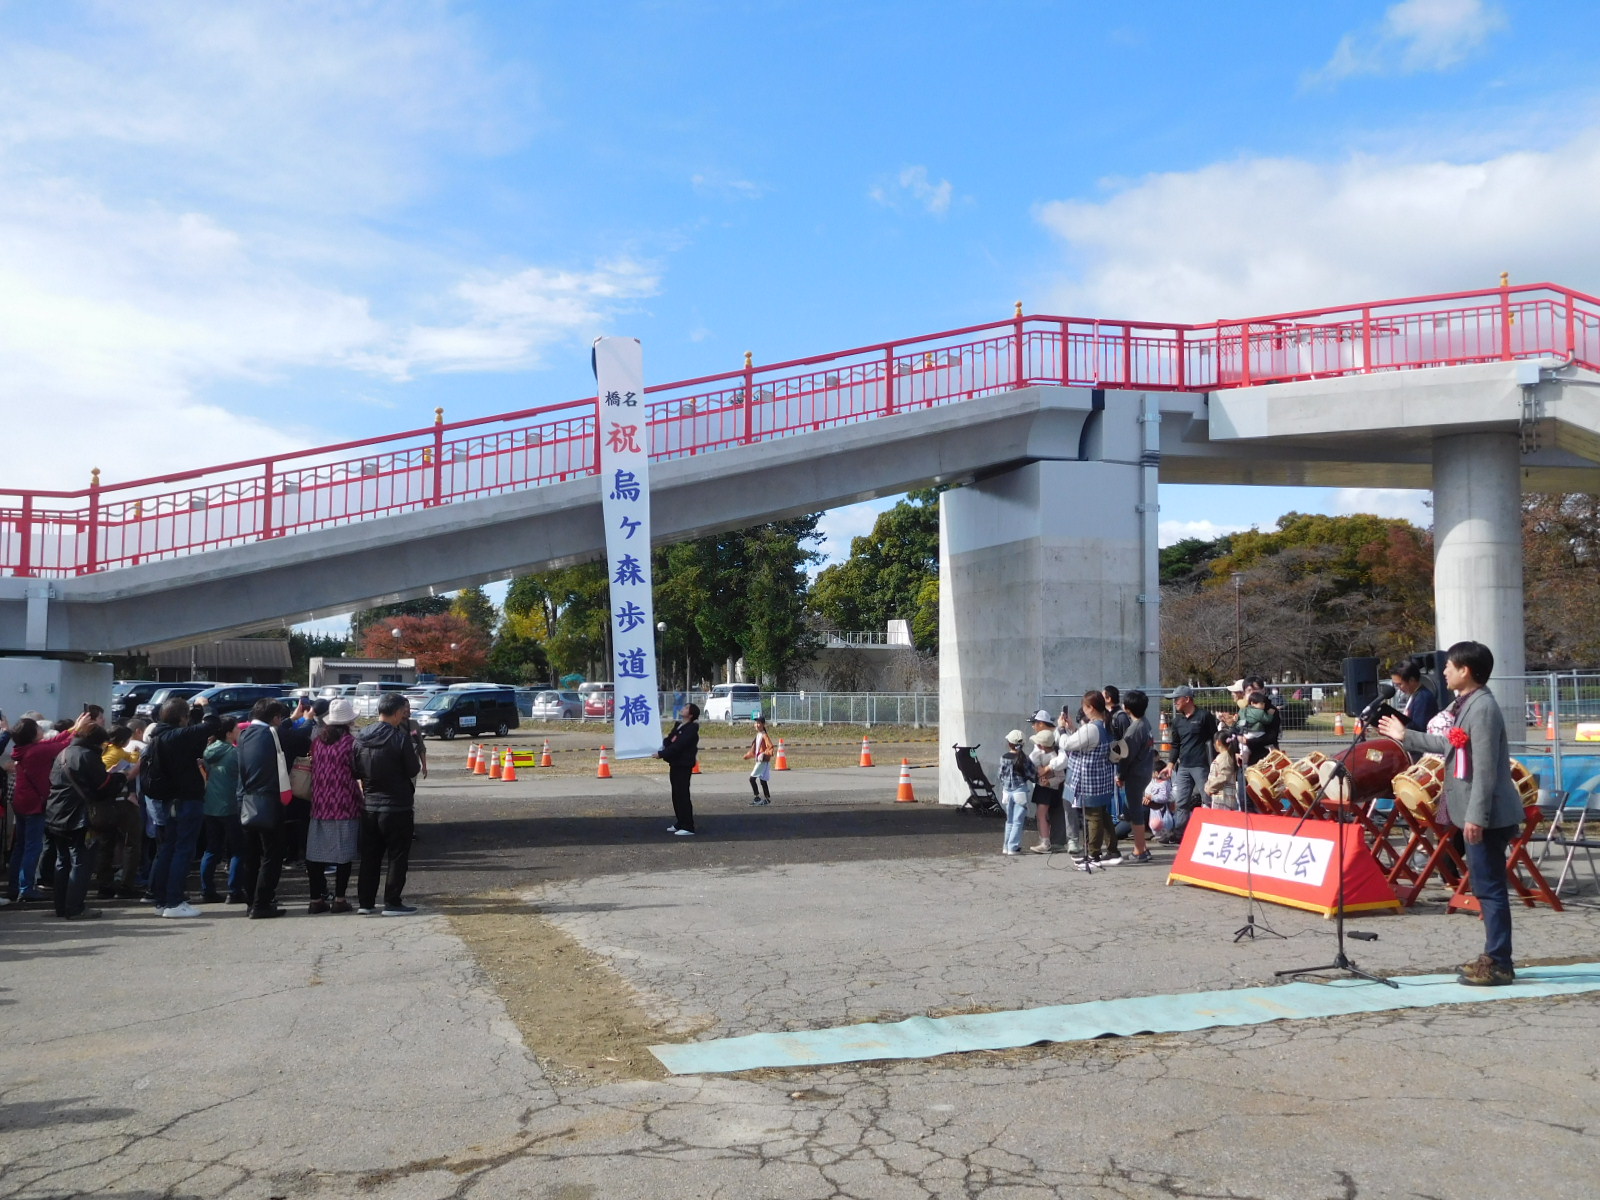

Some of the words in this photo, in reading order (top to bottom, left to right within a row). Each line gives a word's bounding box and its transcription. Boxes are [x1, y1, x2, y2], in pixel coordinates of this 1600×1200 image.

[605, 391, 638, 407] 橋名
[605, 422, 642, 454] 祝
[1202, 831, 1317, 878] 三島おはやし会
